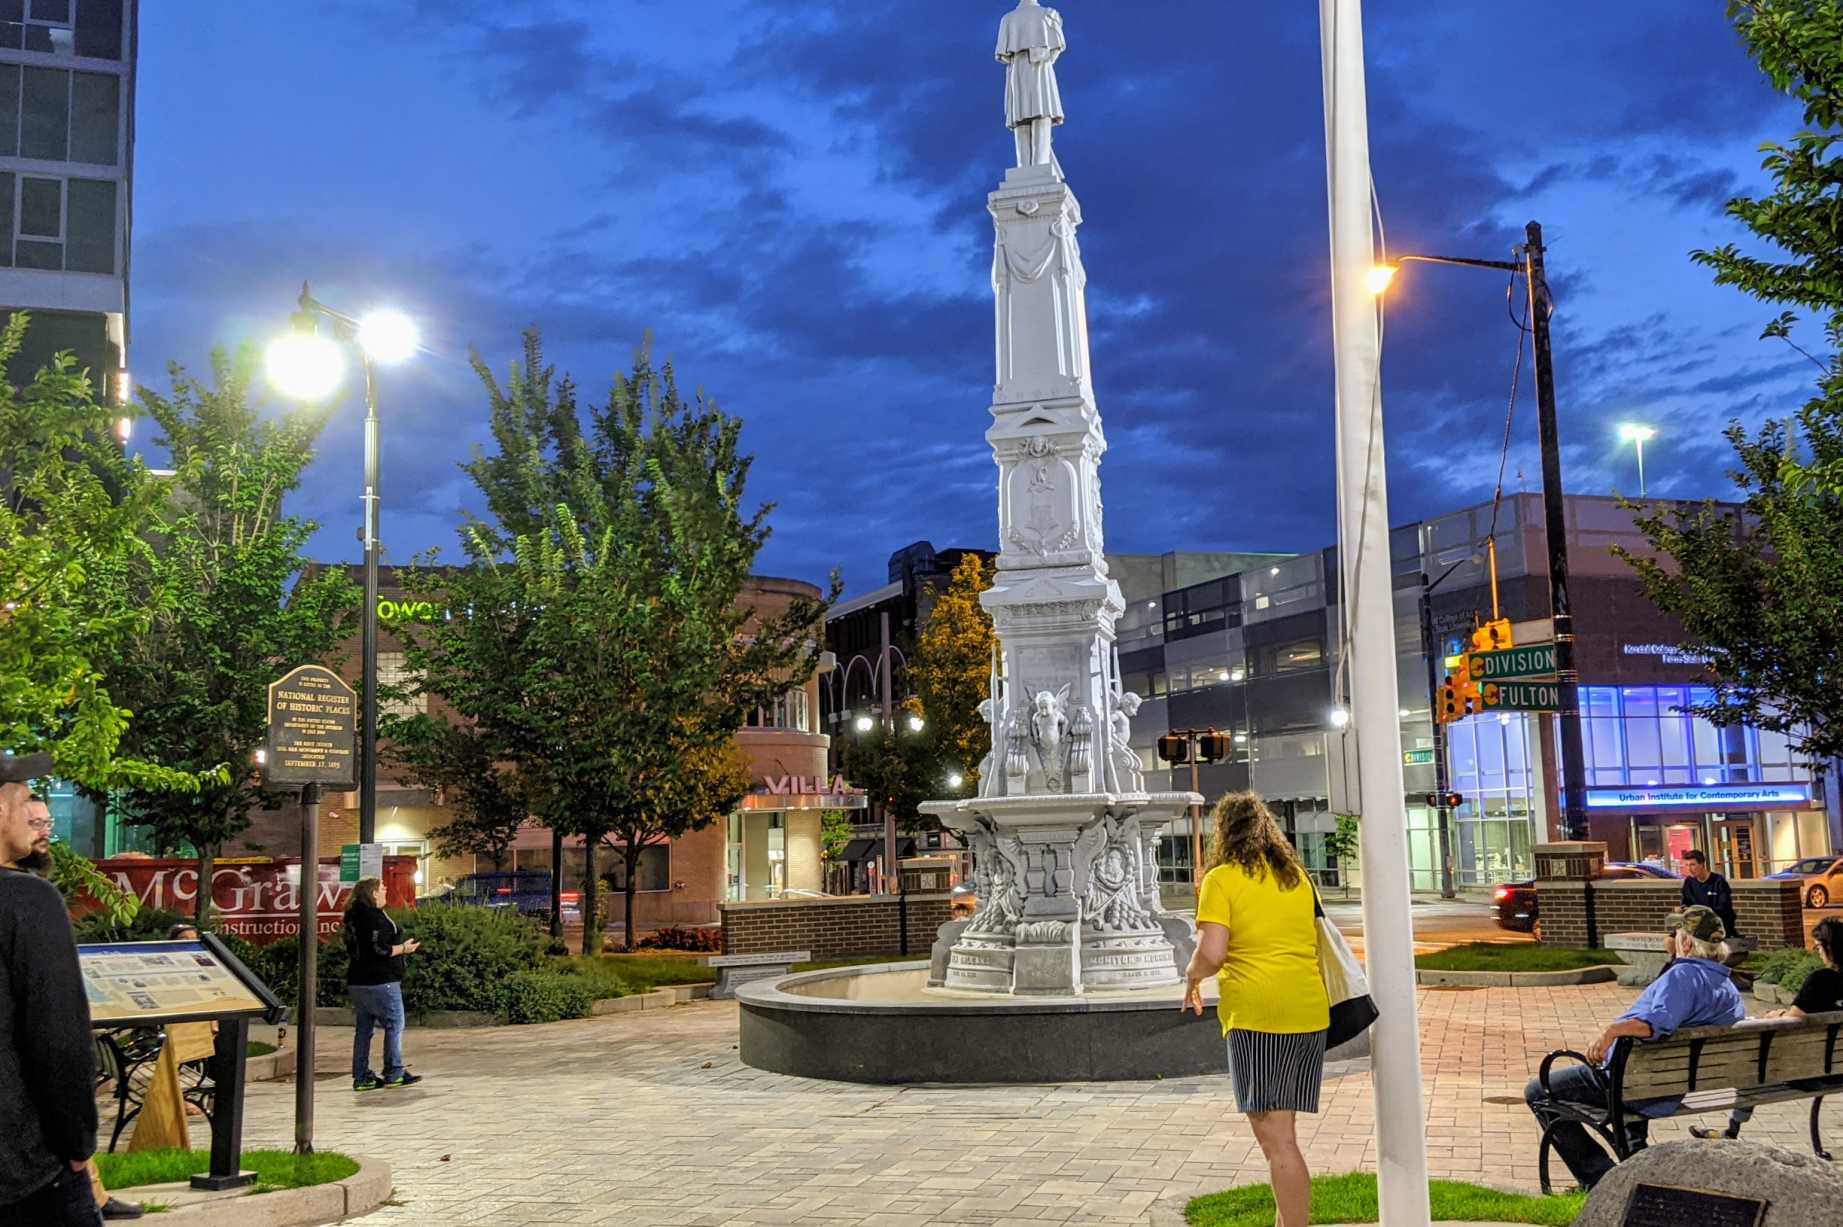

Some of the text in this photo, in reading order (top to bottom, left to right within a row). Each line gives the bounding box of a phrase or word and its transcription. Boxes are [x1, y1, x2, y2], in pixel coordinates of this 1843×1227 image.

[1485, 650, 1556, 675] DIVISION
[278, 690, 350, 704] NATIONAL REGISTER
[1499, 686, 1559, 706] FULTON
[276, 701, 351, 715] OF HISTORIC PLACES
[762, 773, 847, 795] VILLA
[1619, 788, 1780, 801] Urban Institute for Contemporary Arts
